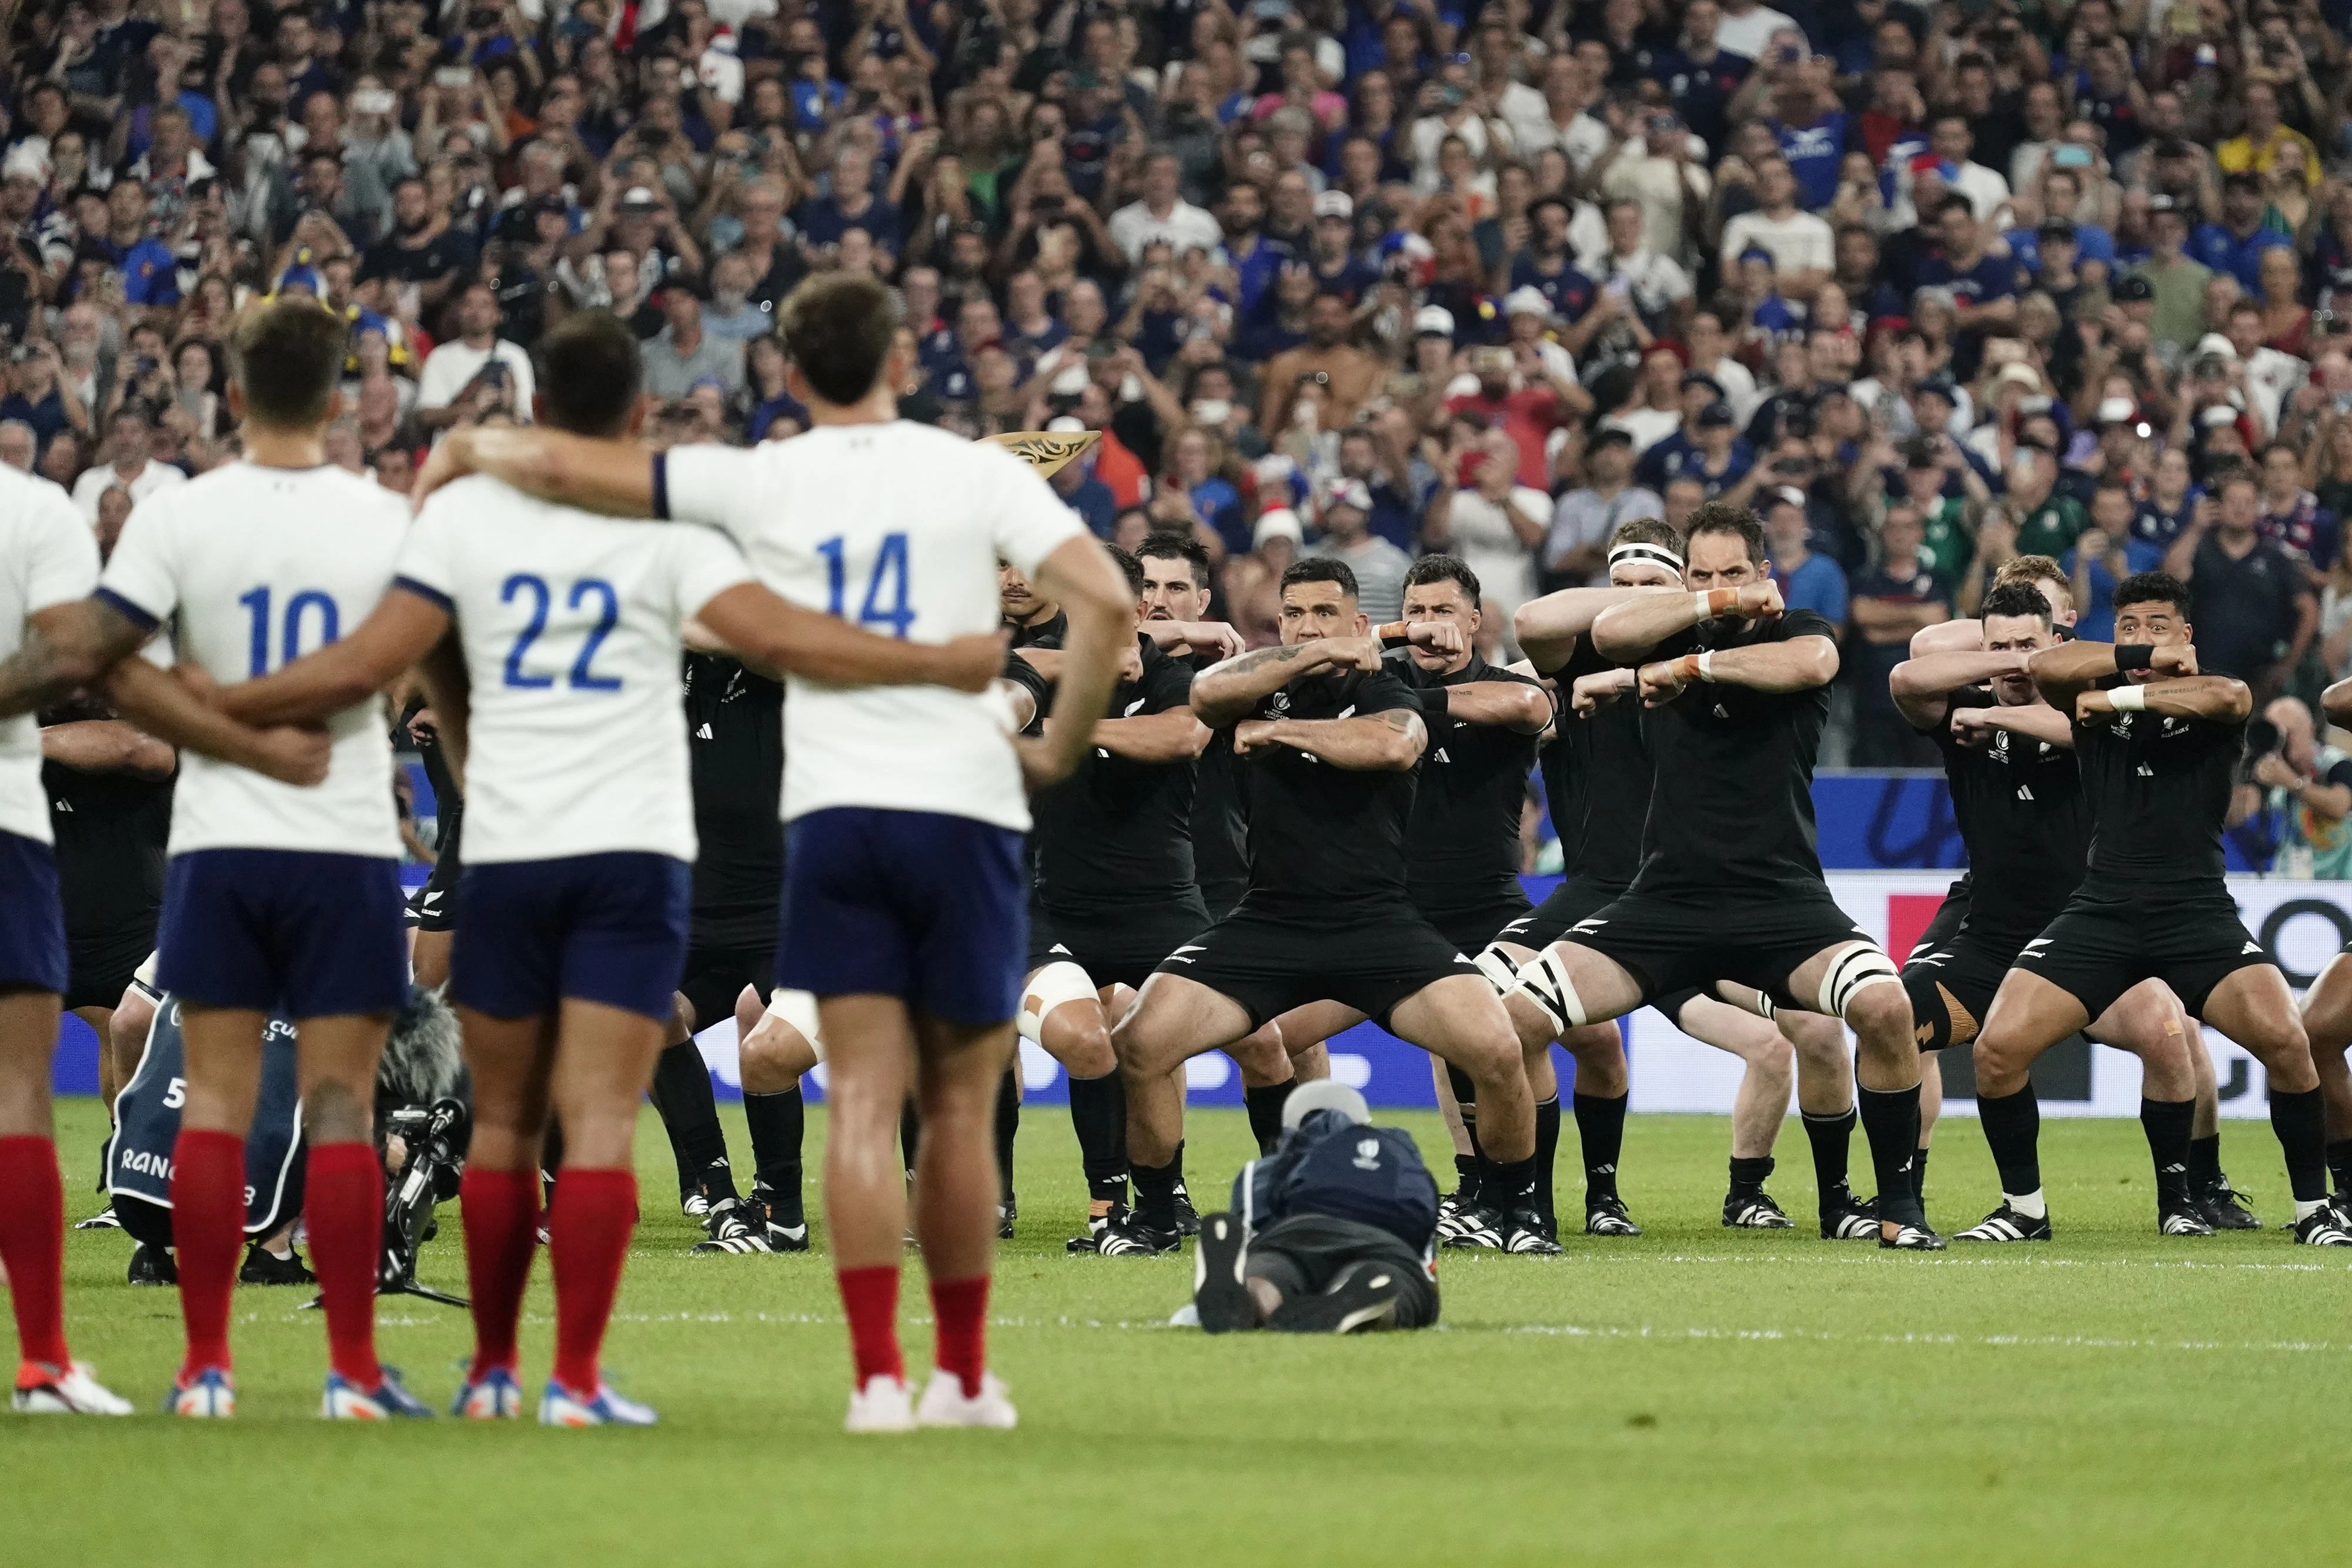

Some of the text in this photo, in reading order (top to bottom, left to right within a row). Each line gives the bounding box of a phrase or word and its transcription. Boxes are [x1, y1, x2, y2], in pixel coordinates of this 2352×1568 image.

[239, 585, 339, 678] 10
[502, 573, 622, 689] 22
[816, 533, 917, 639] 14
[162, 1077, 188, 1109] 5
